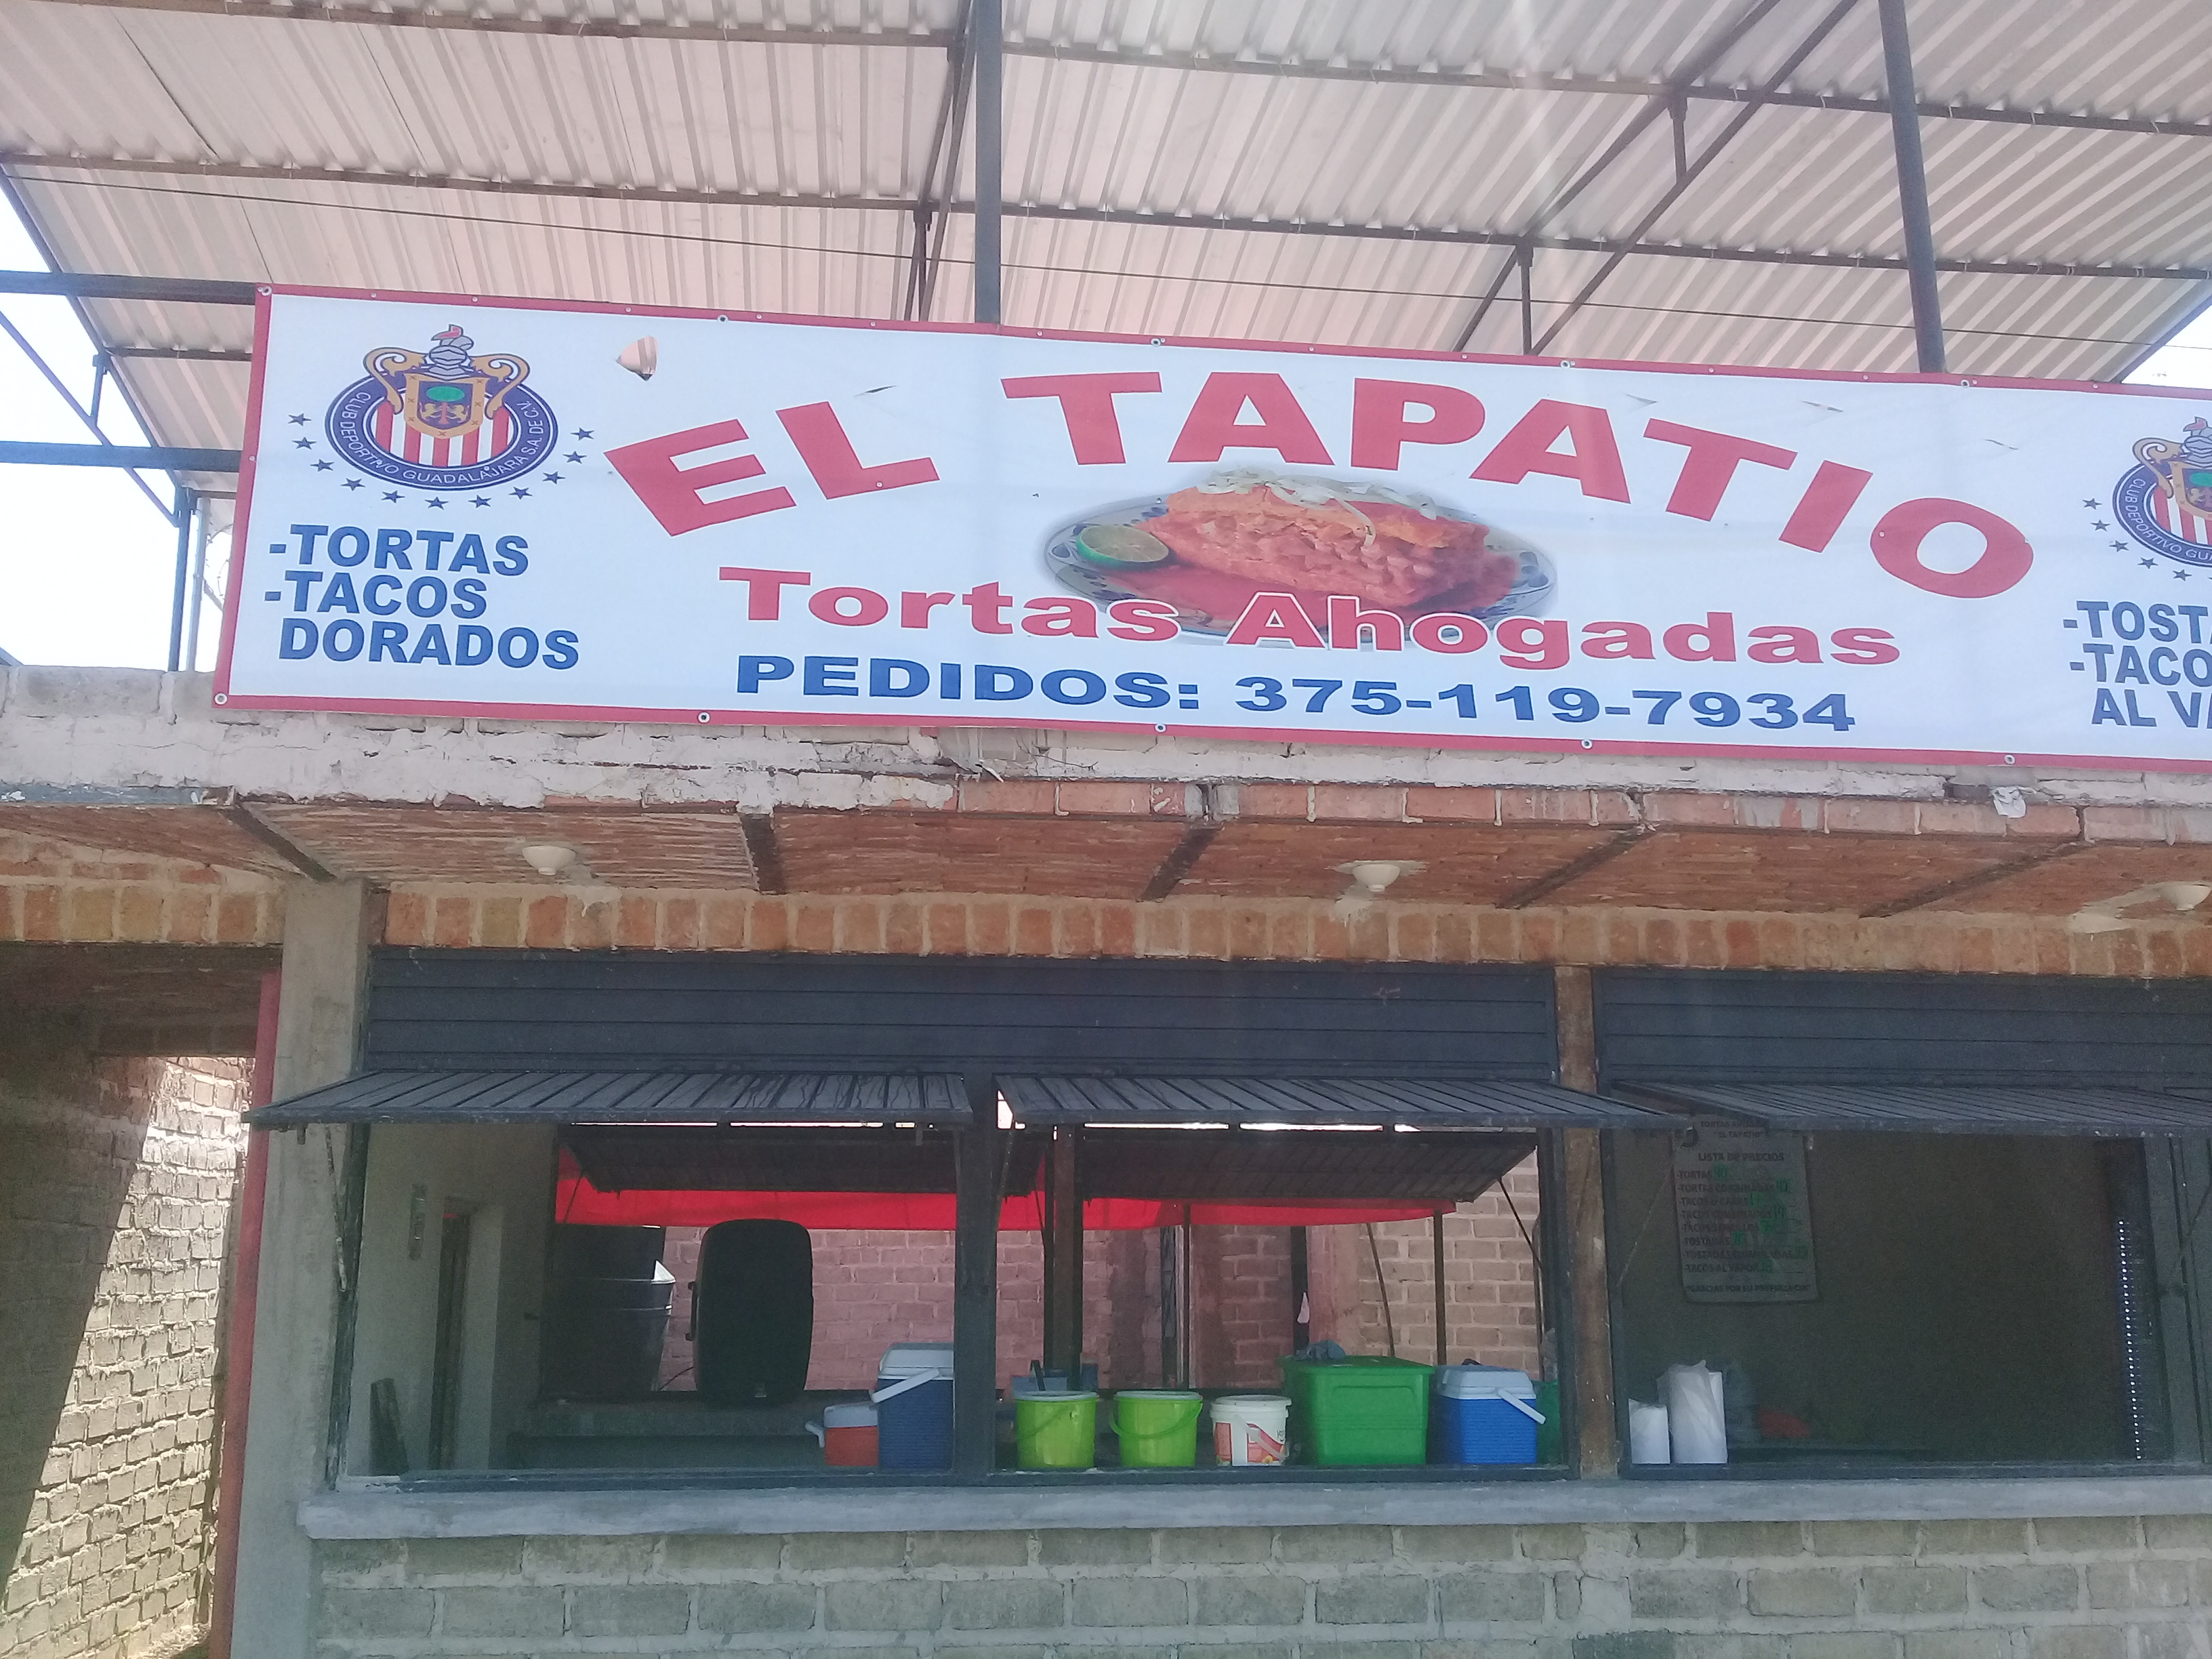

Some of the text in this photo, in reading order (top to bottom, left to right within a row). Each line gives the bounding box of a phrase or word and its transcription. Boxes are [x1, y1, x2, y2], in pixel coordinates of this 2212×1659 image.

[342, 392, 371, 421] CLUB
[528, 419, 544, 435] DE
[340, 422, 399, 474] DEPORTIVO
[403, 455, 523, 484] GUADALAJARA
[603, 371, 2034, 598] EL TAPATIO
[2125, 478, 2212, 560] CLUB DEPORTIVO GU
[269, 524, 529, 576] -TORTAS
[264, 571, 487, 619] -TACOS
[719, 567, 1900, 670] Tortas Ahogadas
[279, 618, 579, 670] DORADOS
[2062, 600, 2212, 642] -TOST
[737, 655, 1856, 731] PEDIDOS: 375-119-7934
[2091, 688, 2212, 729] AL V
[1698, 1153, 1725, 1161] LISTA
[1742, 1153, 1785, 1161] PRECIOS
